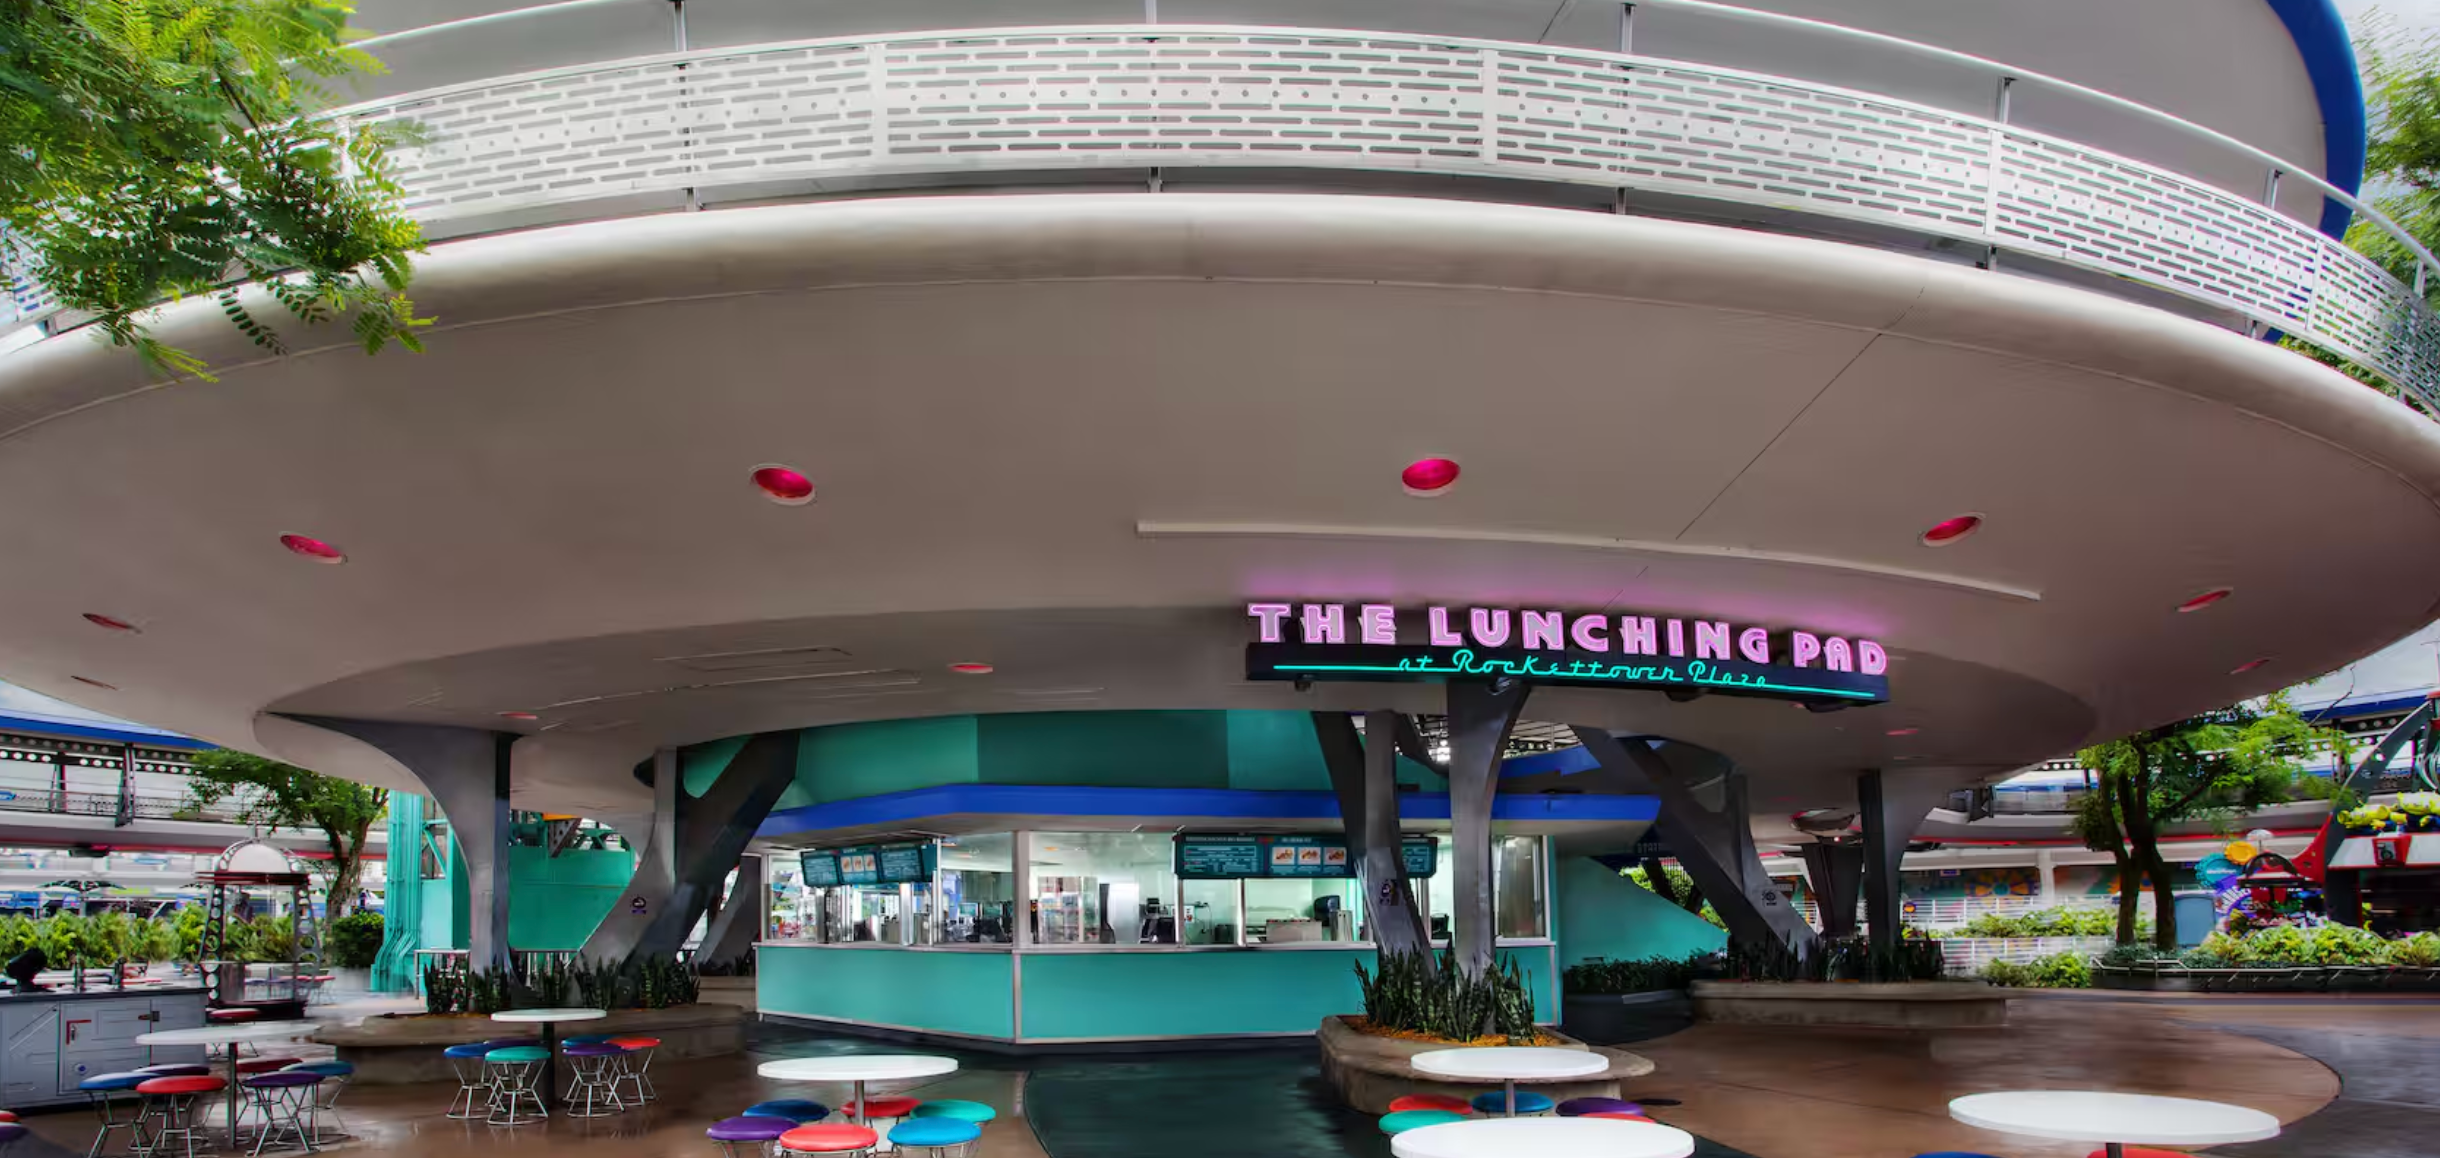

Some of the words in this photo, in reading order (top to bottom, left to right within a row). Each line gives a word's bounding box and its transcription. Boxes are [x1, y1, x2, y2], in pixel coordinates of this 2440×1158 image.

[1248, 603, 1396, 643] THE
[1428, 606, 1770, 664] LUNCHING
[1792, 630, 1888, 676] PAD
[1398, 655, 1433, 672] at
[1687, 659, 1768, 687] Plaza
